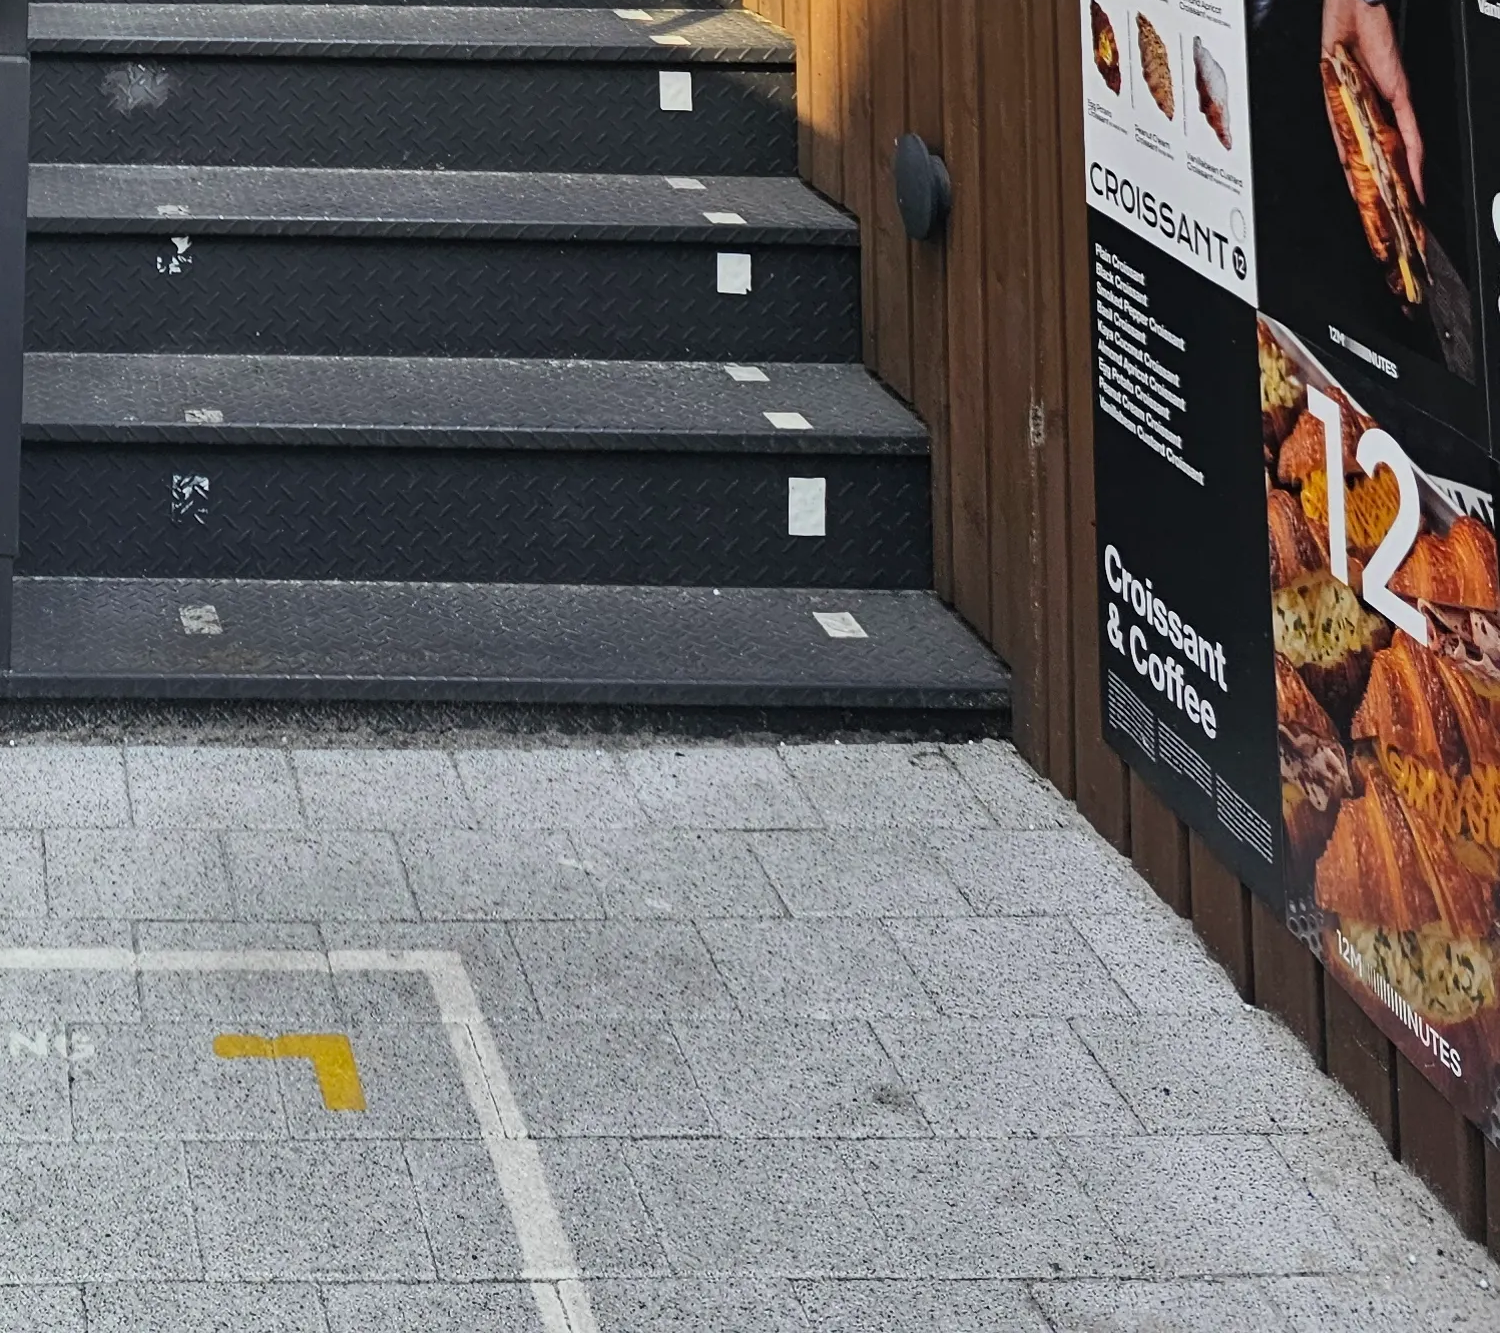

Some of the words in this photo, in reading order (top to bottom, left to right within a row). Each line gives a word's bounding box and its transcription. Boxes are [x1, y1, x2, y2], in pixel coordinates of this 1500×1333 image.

[1089, 162, 1229, 270] CROISSANT
[1306, 384, 1428, 647] 12
[1105, 544, 1228, 692] Croissant
[1107, 602, 1126, 656] &
[1130, 625, 1217, 739] Coffee
